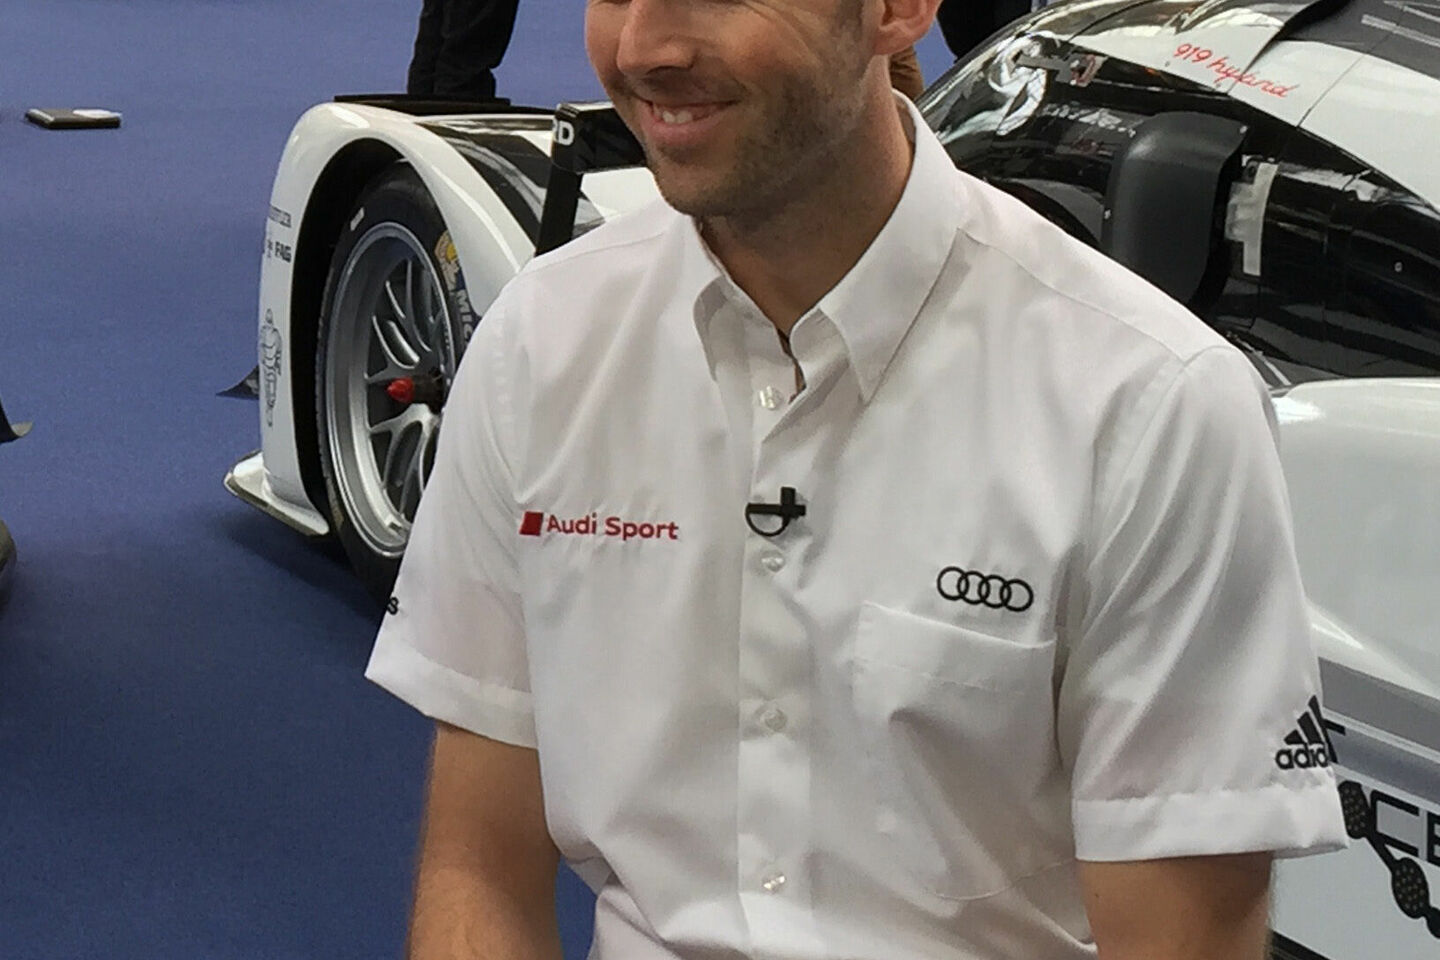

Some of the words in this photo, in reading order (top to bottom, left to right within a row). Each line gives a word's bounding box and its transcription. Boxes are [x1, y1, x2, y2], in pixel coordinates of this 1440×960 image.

[1173, 43, 1212, 63] 919
[546, 512, 598, 536] Audi
[604, 516, 680, 542] Sport
